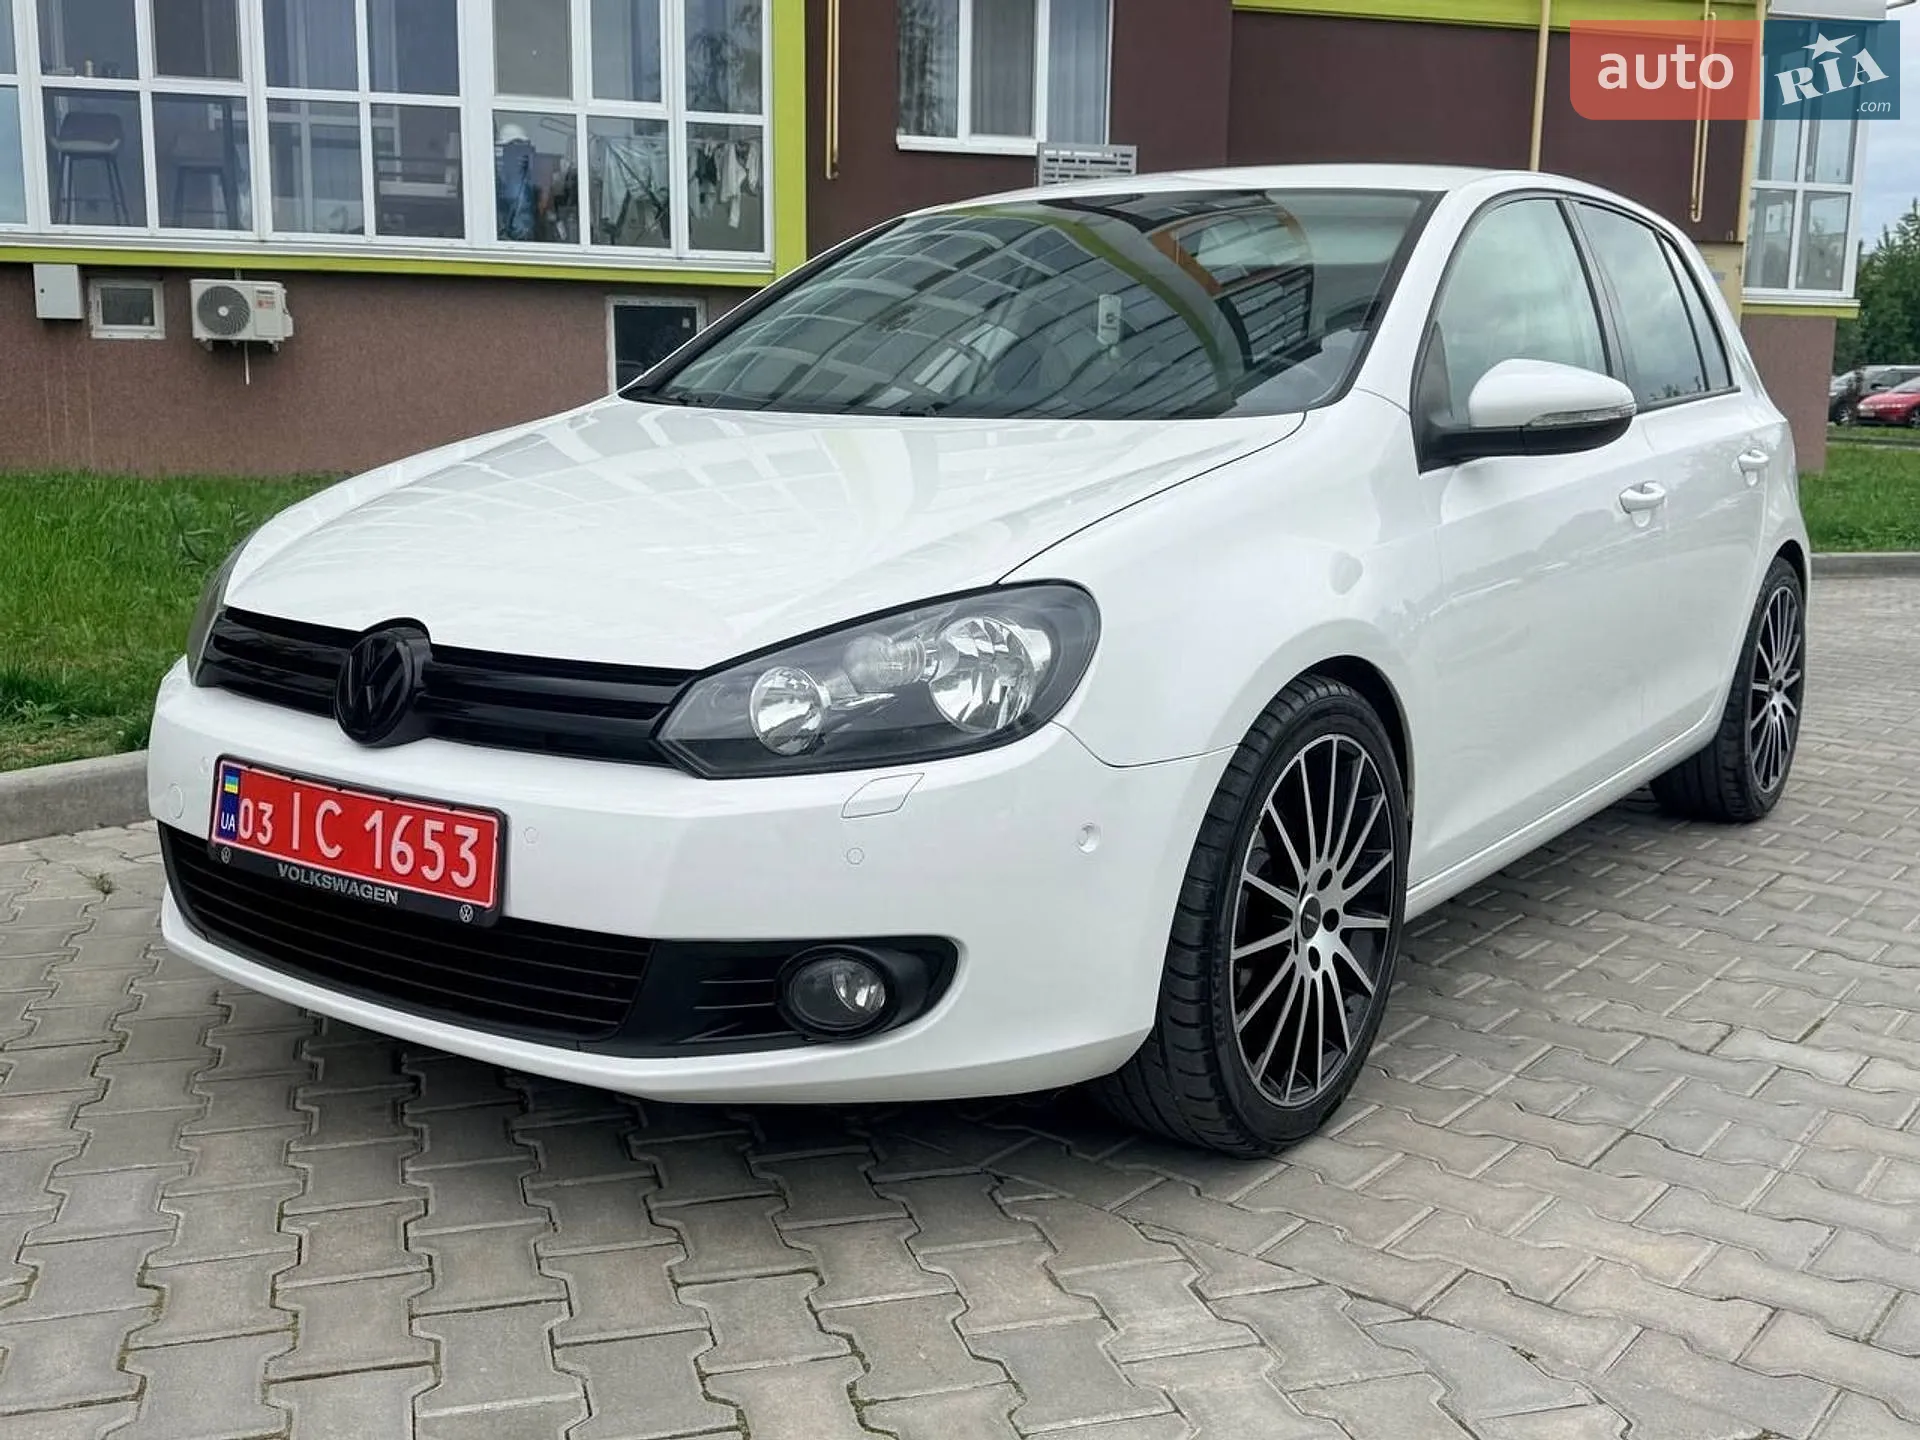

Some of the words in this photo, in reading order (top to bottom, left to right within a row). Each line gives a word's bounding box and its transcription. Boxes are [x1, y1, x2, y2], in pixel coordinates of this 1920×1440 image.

[220, 811, 235, 832] UA
[239, 798, 274, 846] 03
[363, 809, 479, 888] 1653
[278, 862, 398, 905] VOLKSWAGEN
